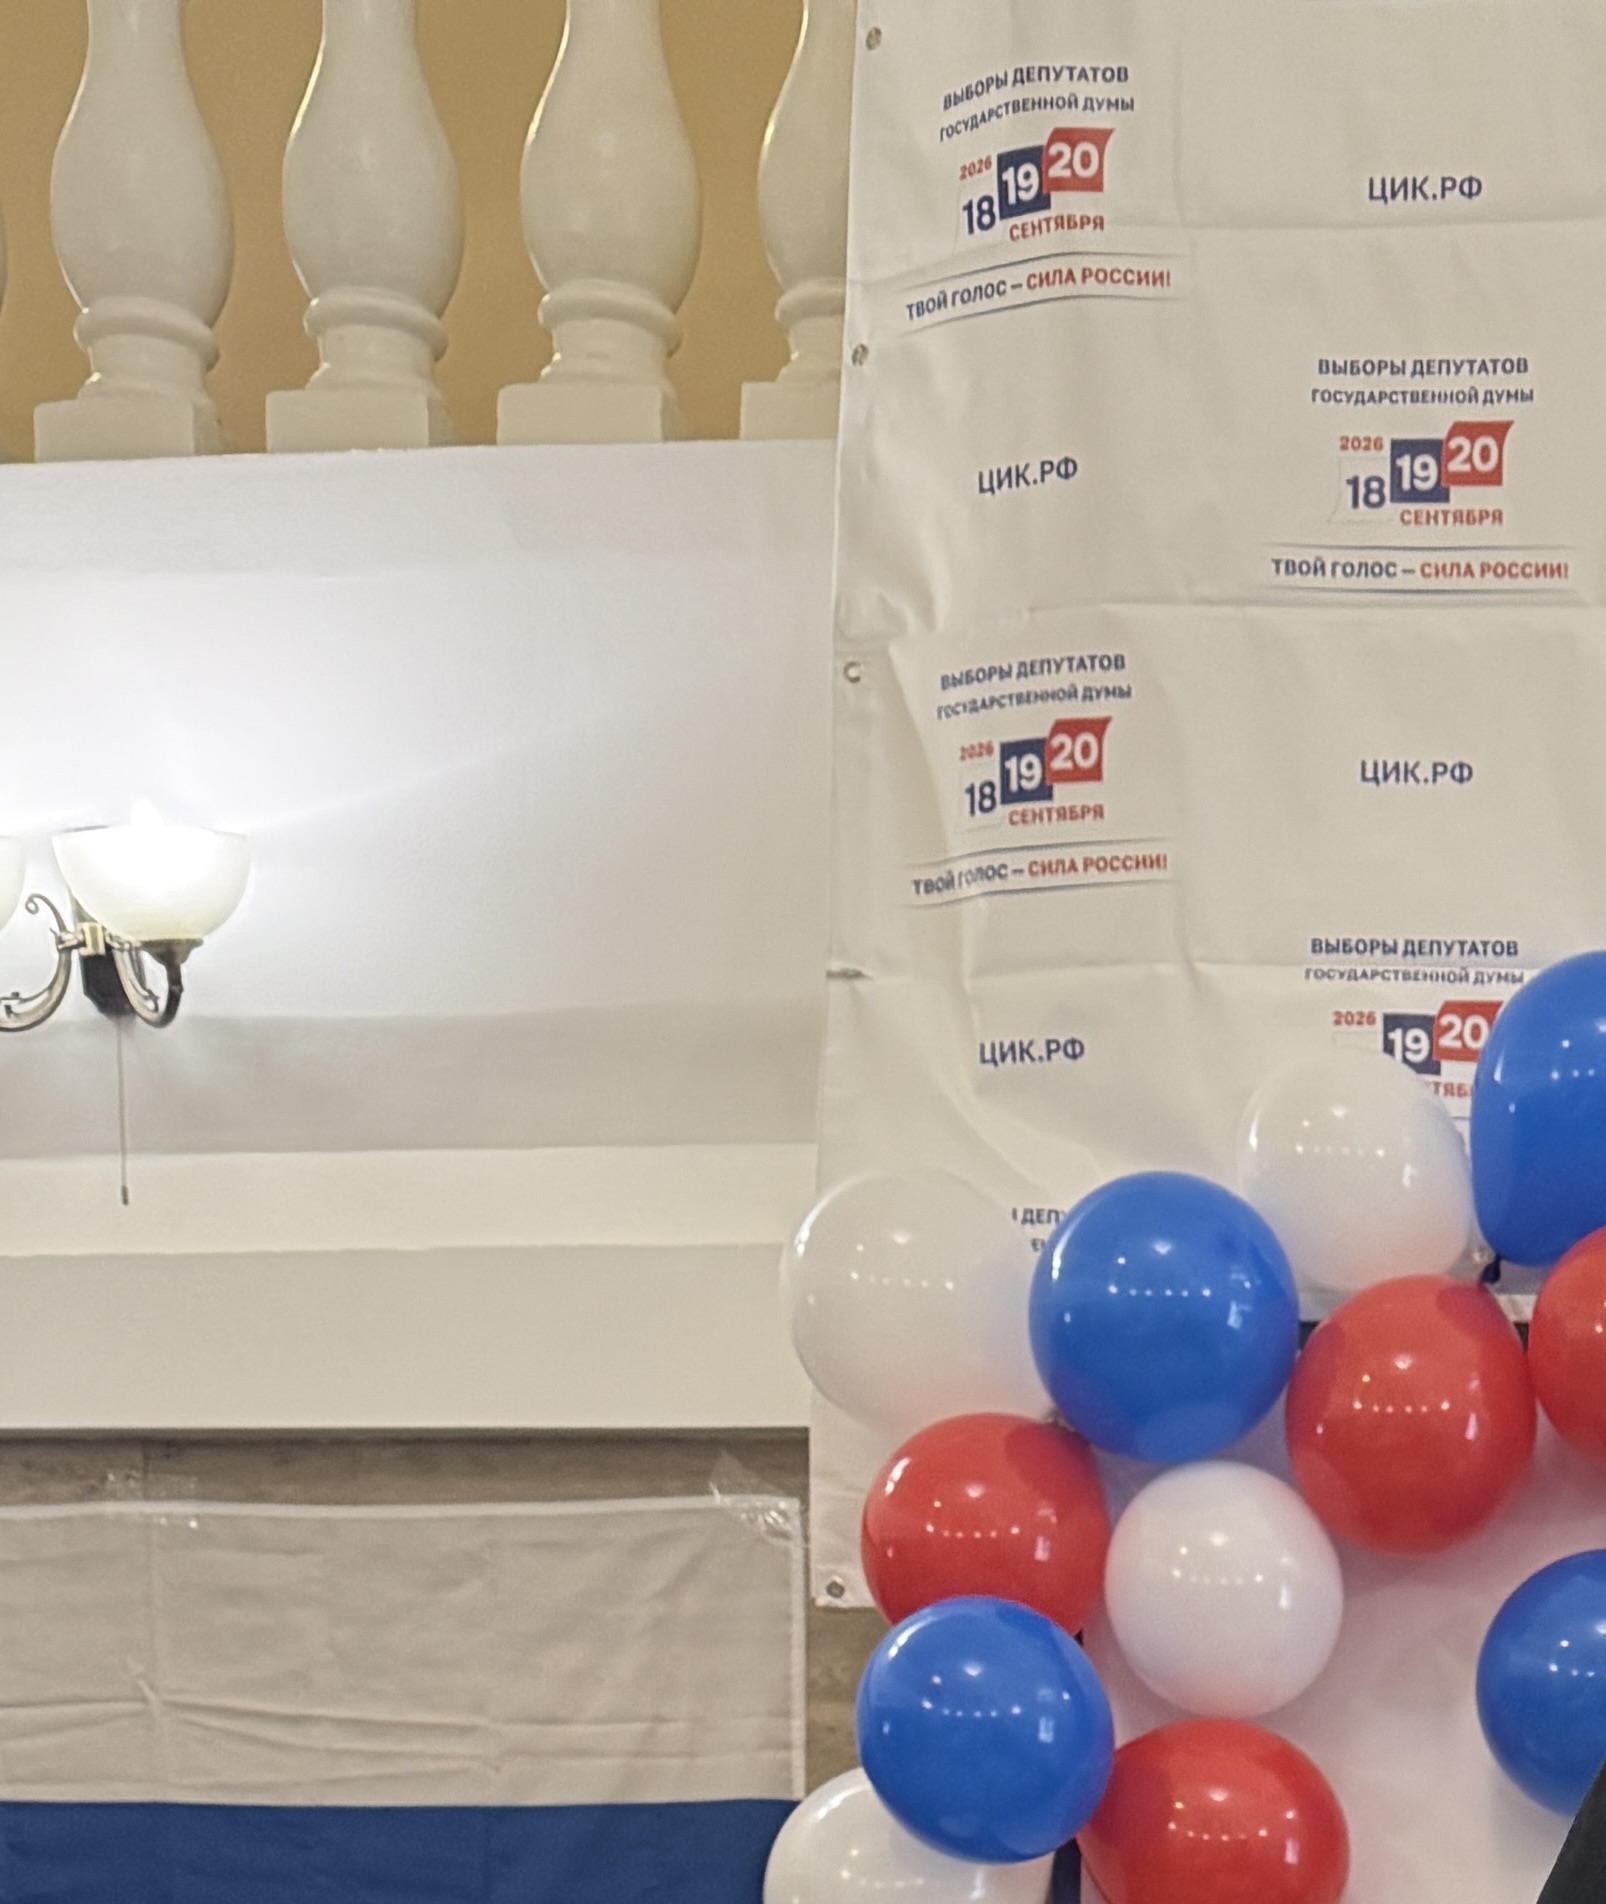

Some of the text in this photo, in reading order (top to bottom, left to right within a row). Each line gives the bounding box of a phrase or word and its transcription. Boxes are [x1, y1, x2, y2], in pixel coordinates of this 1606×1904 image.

[944, 66, 1128, 113] ВЫБОРЫ ДЕПУТАТОВ
[940, 94, 1134, 144] ГОСУДАРСТВЕННОЙ ДУМЫ
[960, 155, 992, 180] 2026
[963, 141, 1099, 236] 18 19 20
[1369, 176, 1482, 205] ЦИК.РФ
[1007, 213, 1104, 241] СЕНТЯБРЯ
[907, 290, 948, 322] ТВОЙ
[952, 280, 1008, 312] ГОЛОС
[1027, 268, 1076, 290] СИЛА
[1082, 268, 1170, 287] РОССИИ!
[1319, 358, 1528, 378] ВЫБОРЫ ДЕПУТАТОВ
[1312, 386, 1533, 406] ГОСУДАРСТВЕННОЙ ДУМЫ
[1340, 436, 1383, 451] 2026
[979, 457, 1077, 495] ЦИК.РФ
[1346, 436, 1498, 509] 18 19 20
[1400, 509, 1503, 525] СЕНТЯБРЯ
[1272, 557, 1326, 576] ТВОЙ
[1331, 561, 1397, 578] ГОЛОС
[1420, 562, 1475, 578] СИЛА
[1480, 562, 1568, 578] РОССИИ!
[941, 654, 1125, 691] ВЫБОРЫ ДЕПУТАТОВ
[937, 683, 1131, 718] ГОСУДАРСТВЕННОЙ ДУМЫ
[965, 733, 1098, 816] 18 19 20
[1361, 760, 1473, 786] ЦИК.РФ
[1007, 803, 1104, 826] СЕНТЯБРЯ
[913, 870, 955, 895] ТВОЙ
[958, 863, 1009, 887] ГОЛОС
[1028, 858, 1078, 877] СИЛА
[1311, 938, 1518, 958] ВЫБОРЫ ДЕПУТАТОВ
[1305, 965, 1524, 985] ГОСУДАРСТВЕННОЙ ДУМЫ
[1334, 1011, 1376, 1026] 2026
[980, 1038, 1084, 1067] ЦИК.РФ
[1389, 1013, 1487, 1063] 19 20
